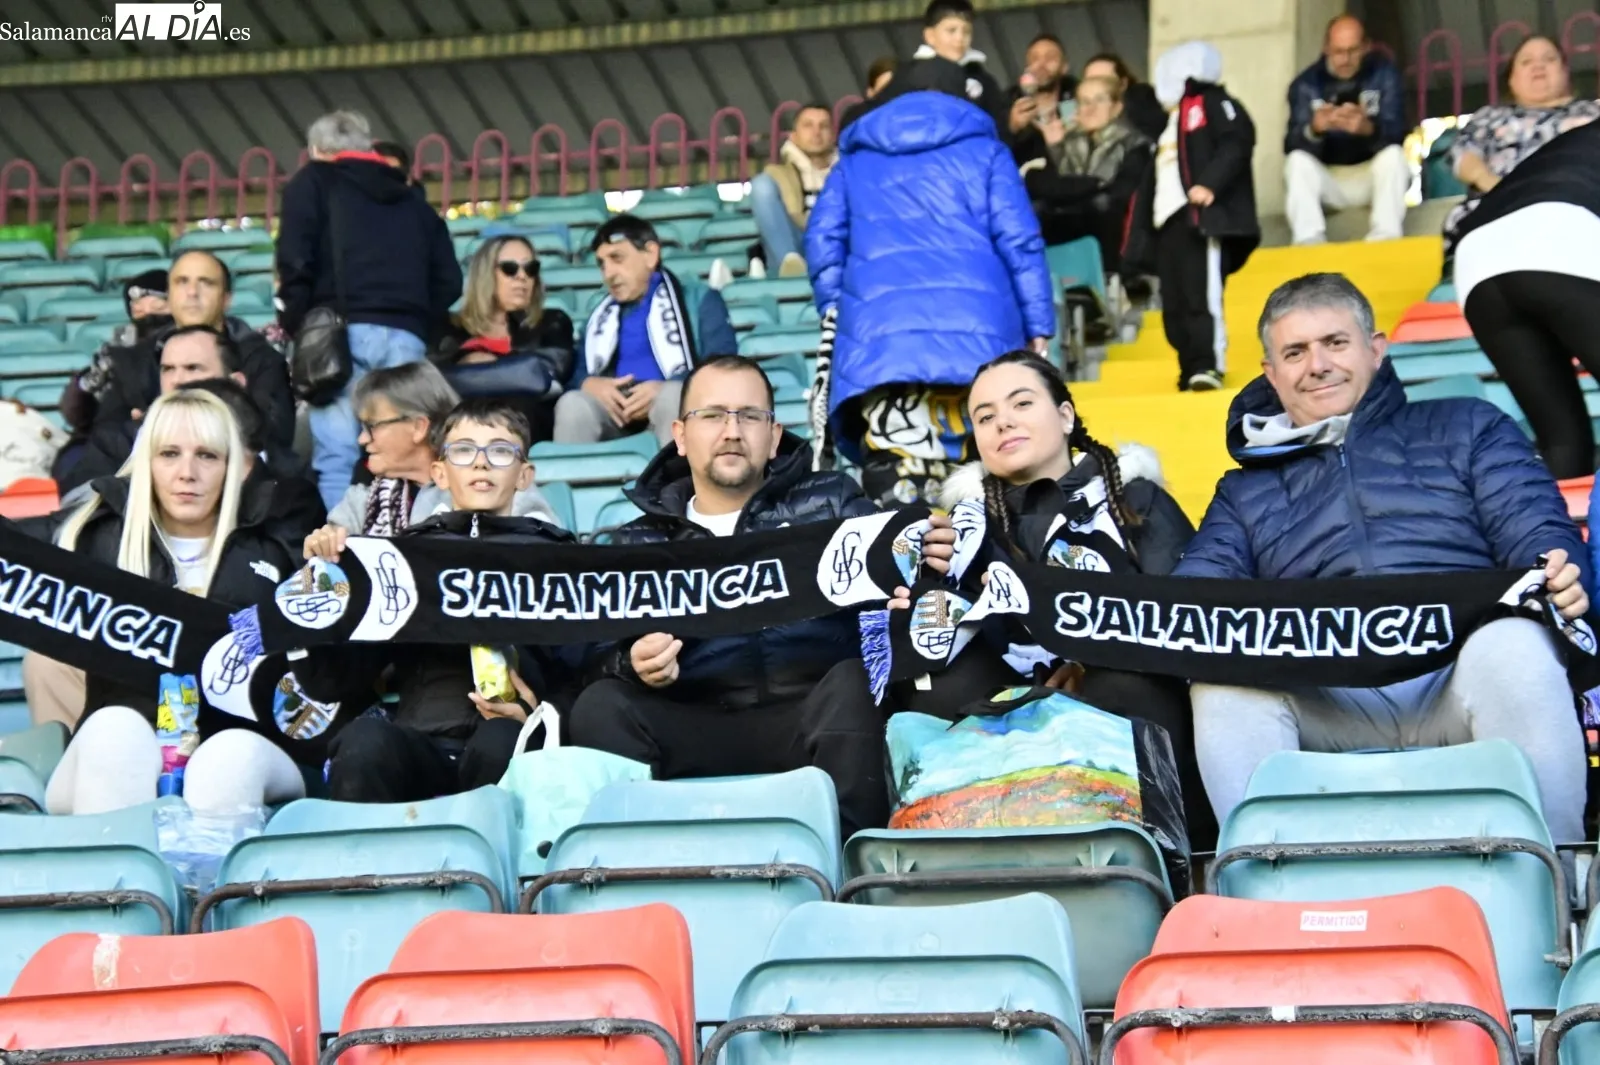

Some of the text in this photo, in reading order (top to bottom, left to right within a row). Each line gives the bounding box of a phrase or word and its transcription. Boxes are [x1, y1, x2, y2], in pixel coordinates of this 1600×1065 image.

[438, 558, 790, 620] SALAMANCA
[1054, 591, 1454, 657] SALAMANCA
[1302, 914, 1365, 927] PERMITIDO
